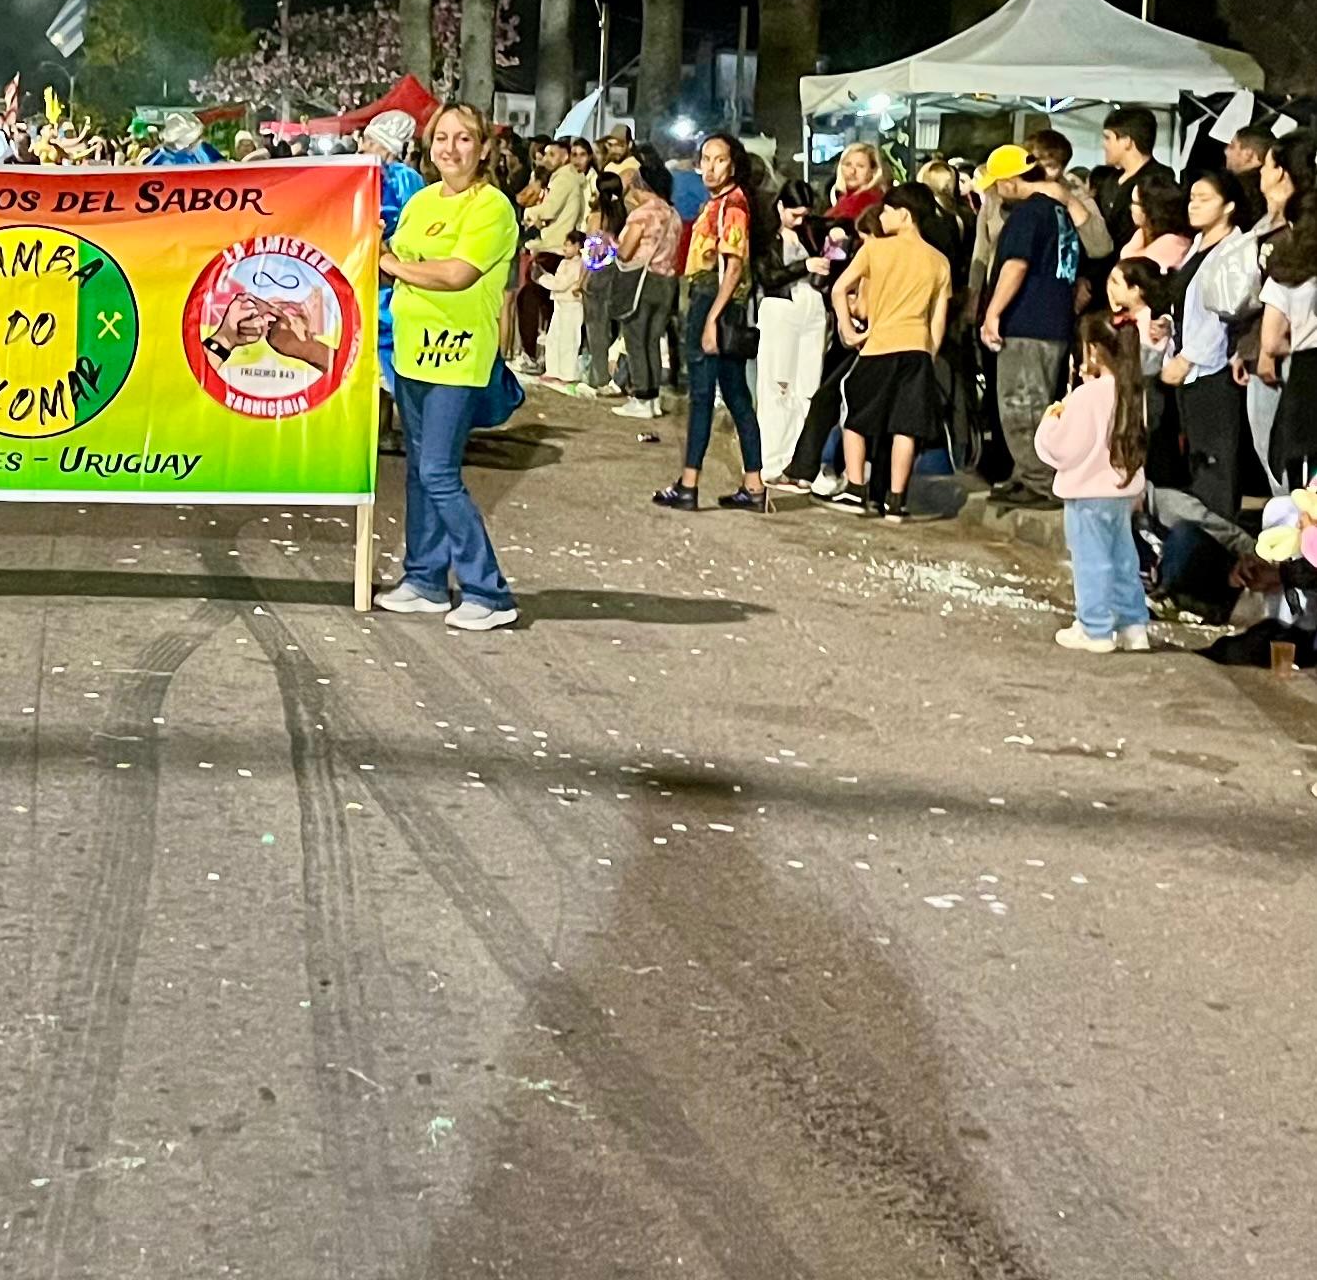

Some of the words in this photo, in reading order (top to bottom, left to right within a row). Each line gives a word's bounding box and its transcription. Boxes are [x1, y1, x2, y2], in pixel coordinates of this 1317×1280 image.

[223, 242, 246, 265] LA
[254, 235, 334, 274] AMISTAD
[5, 310, 56, 345] DO
